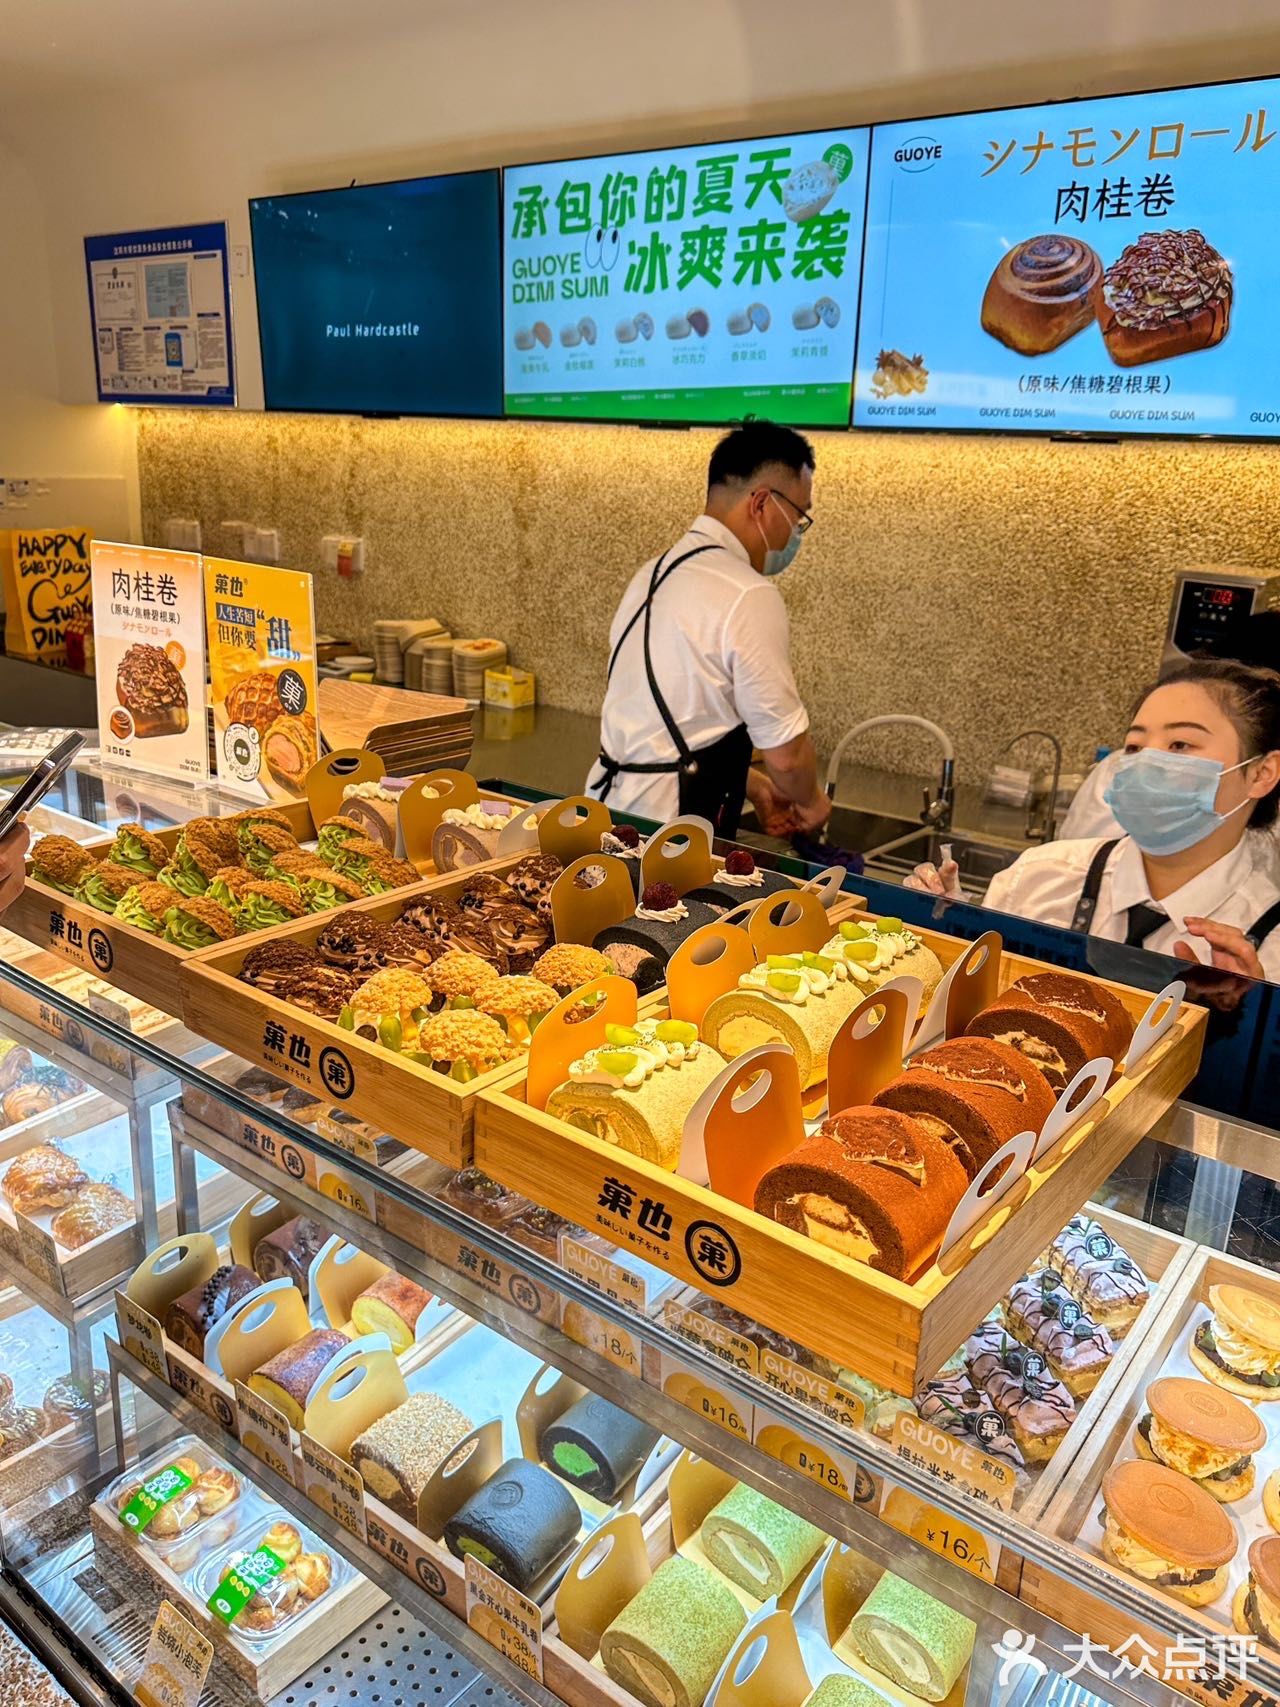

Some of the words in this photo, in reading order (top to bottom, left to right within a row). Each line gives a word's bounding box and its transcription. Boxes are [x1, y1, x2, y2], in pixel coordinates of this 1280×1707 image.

[893, 144, 942, 163] GUOYE
[981, 108, 1278, 178] シナモンロール
[511, 147, 792, 239] 承包你的夏天
[1054, 172, 1176, 225] 肉桂卷
[512, 253, 582, 279] GUOYE
[623, 208, 851, 295] 冰爽来袭
[512, 281, 555, 304] DIM
[560, 275, 610, 299] SUM
[326, 324, 351, 338] Paul
[355, 322, 420, 337] Hardcastle
[867, 406, 897, 416] GUOYE
[979, 407, 1011, 418] GUOYE
[1109, 409, 1145, 421] GUOYE
[1146, 410, 1169, 421] DIM
[1170, 410, 1196, 421] SUM
[18, 532, 87, 559] HAPPY
[112, 567, 178, 607] 肉桂卷
[214, 573, 244, 598] 菓也
[217, 623, 257, 651] 但你要
[49, 910, 83, 949] 菓也
[263, 1019, 312, 1069] 菓也
[243, 1123, 276, 1158] 菓也
[597, 1176, 674, 1242] 菓也
[595, 1212, 671, 1262] 美味しい菓子を作る
[457, 1244, 502, 1287] 菓也
[764, 1355, 829, 1397] GUOYE
[900, 1416, 975, 1471] GUOYE
[368, 1520, 409, 1565] 菓也
[926, 1528, 992, 1573] ¥16/个
[468, 1562, 516, 1606] GUOYE
